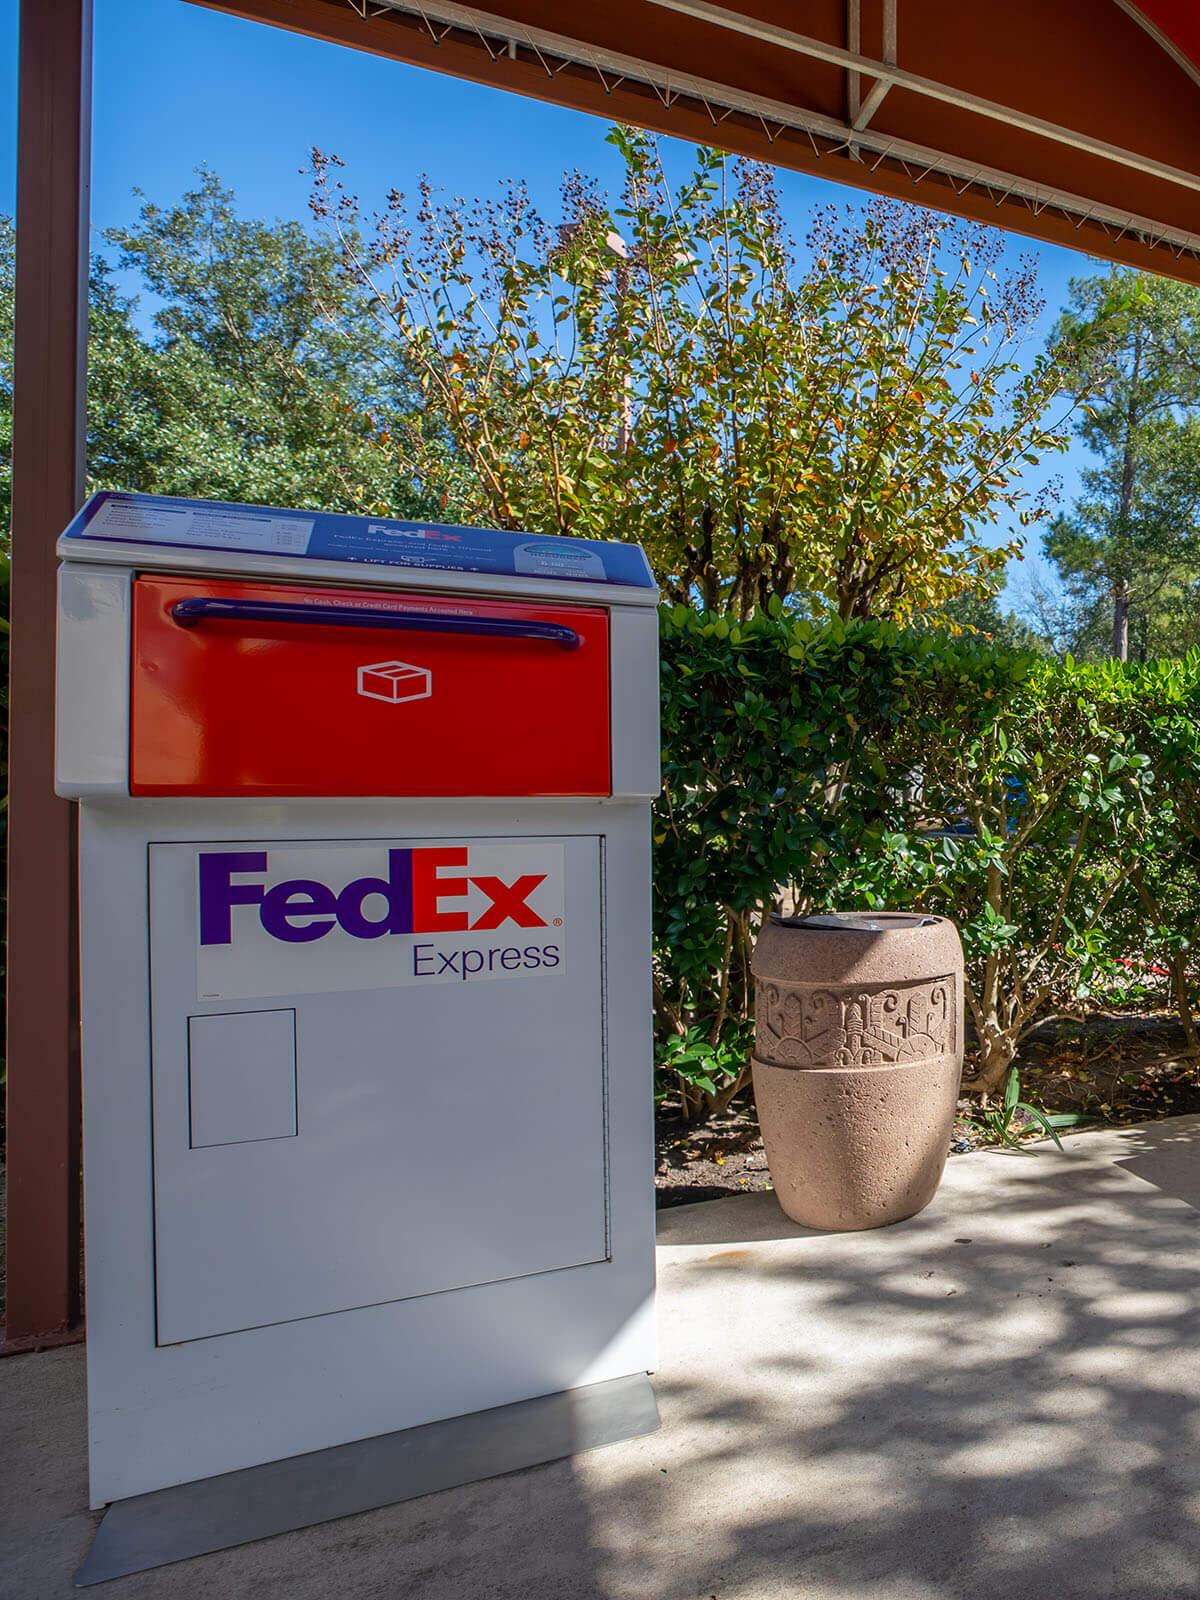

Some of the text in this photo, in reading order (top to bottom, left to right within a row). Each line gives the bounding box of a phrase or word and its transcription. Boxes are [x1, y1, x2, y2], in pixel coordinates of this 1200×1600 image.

[367, 524, 463, 542] FedEx
[413, 562, 464, 571] SUPPLIES
[333, 599, 353, 608] Check
[362, 601, 381, 609] Credit
[382, 602, 398, 611] Card
[399, 603, 428, 613] Payments
[429, 605, 456, 615] Accepted
[457, 608, 473, 616] Here
[413, 944, 560, 980] Express
